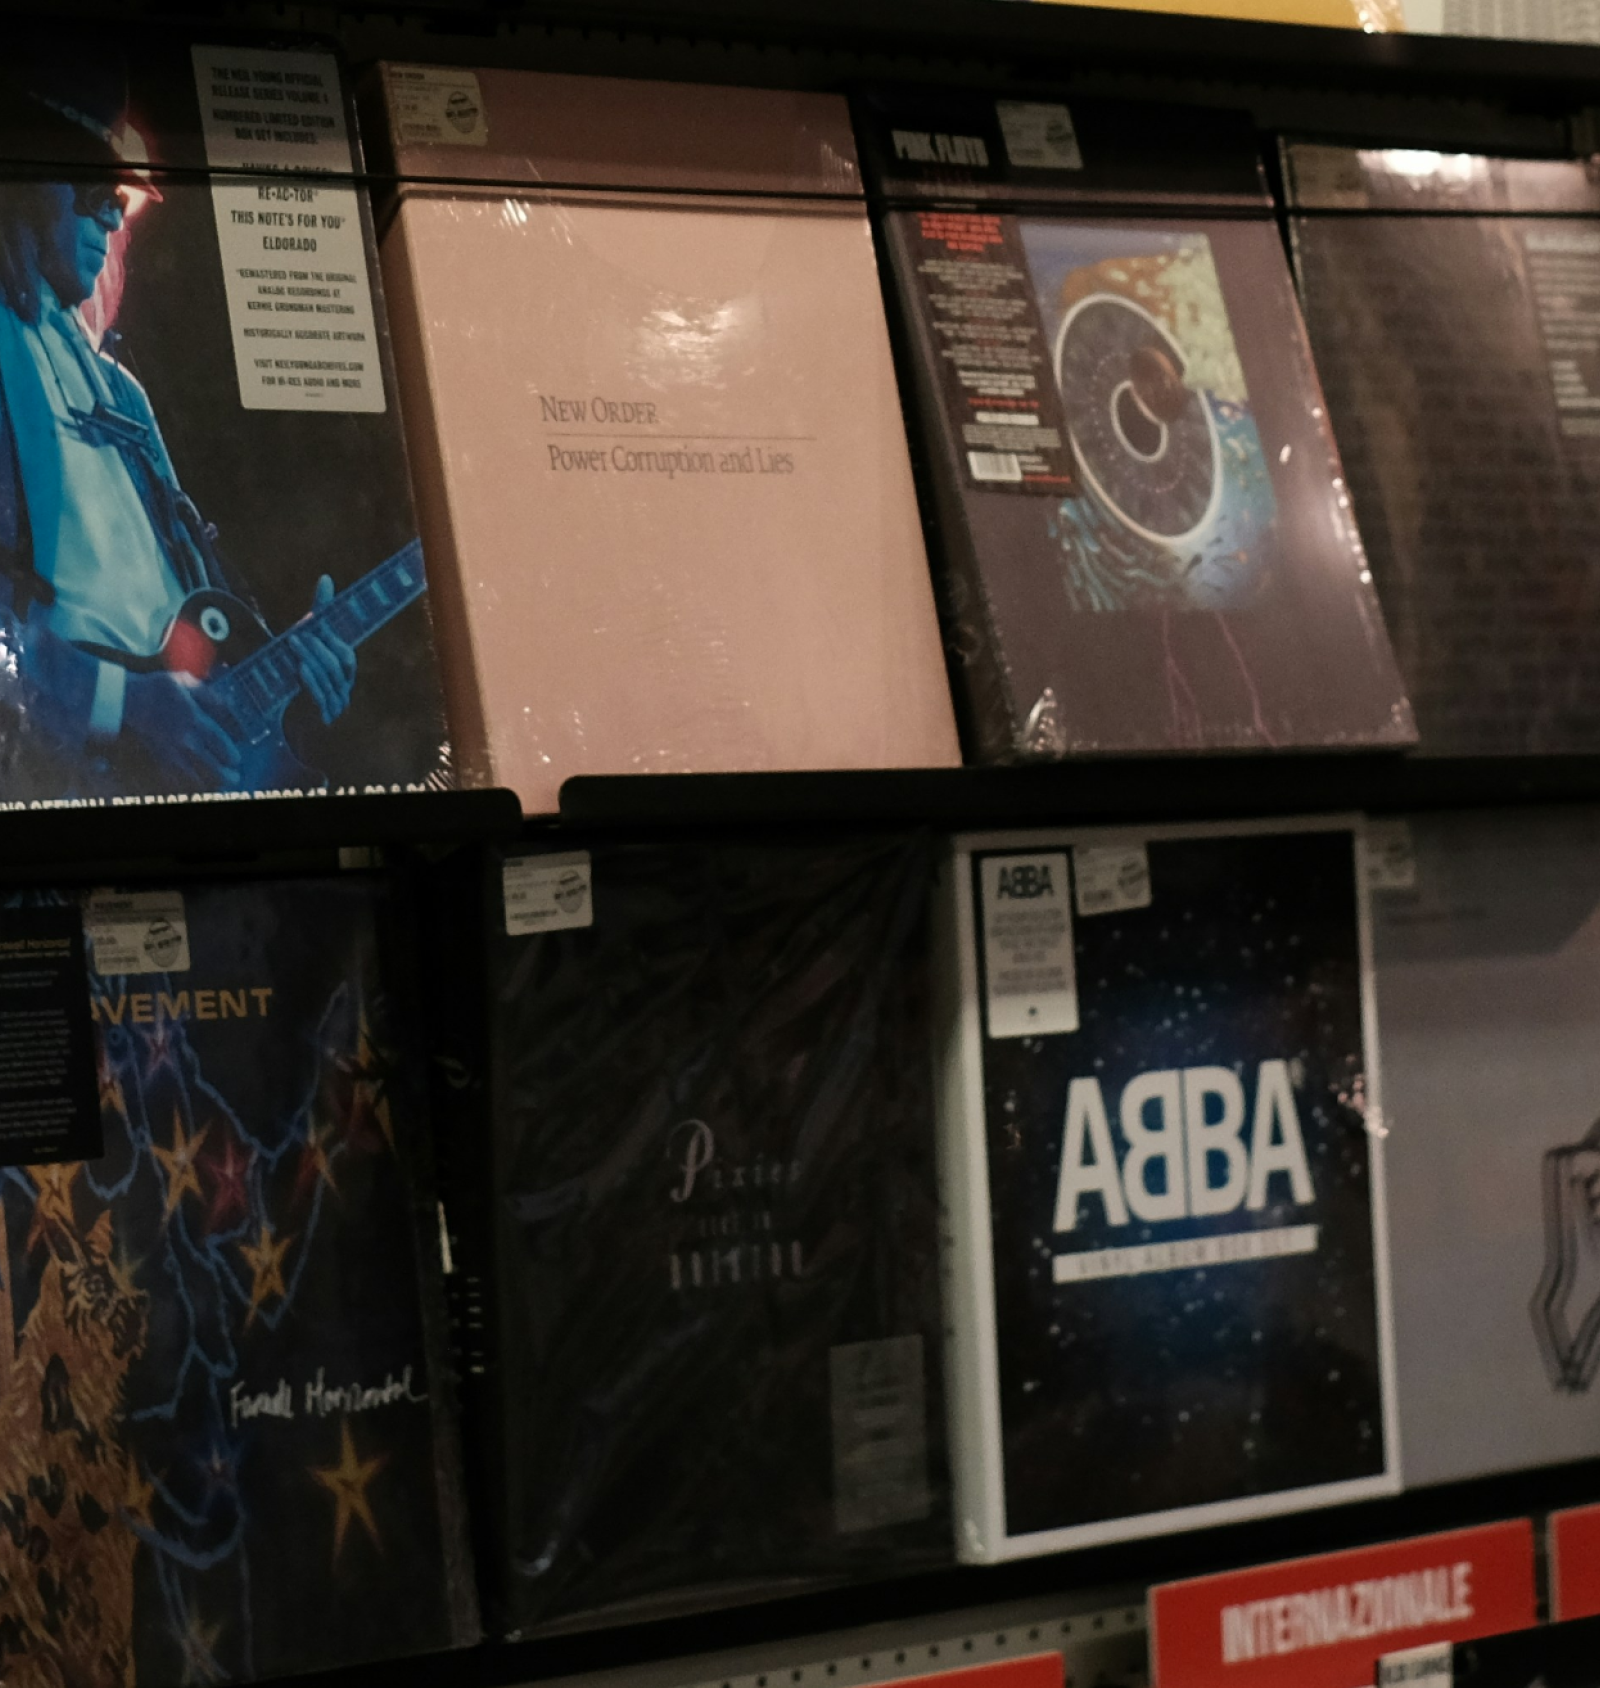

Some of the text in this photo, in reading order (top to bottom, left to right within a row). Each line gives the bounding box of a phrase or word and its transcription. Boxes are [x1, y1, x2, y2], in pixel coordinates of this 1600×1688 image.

[231, 210, 254, 226] THIS
[257, 211, 295, 227] NOTE'S
[297, 213, 318, 228] FOR
[262, 235, 318, 253] ELDORADO
[546, 443, 796, 481] Power Corruption and Lies
[997, 863, 1054, 901] ABBA
[1051, 1057, 1317, 1234] ABBA
[1220, 1559, 1476, 1666] INTERNAZIONALE
